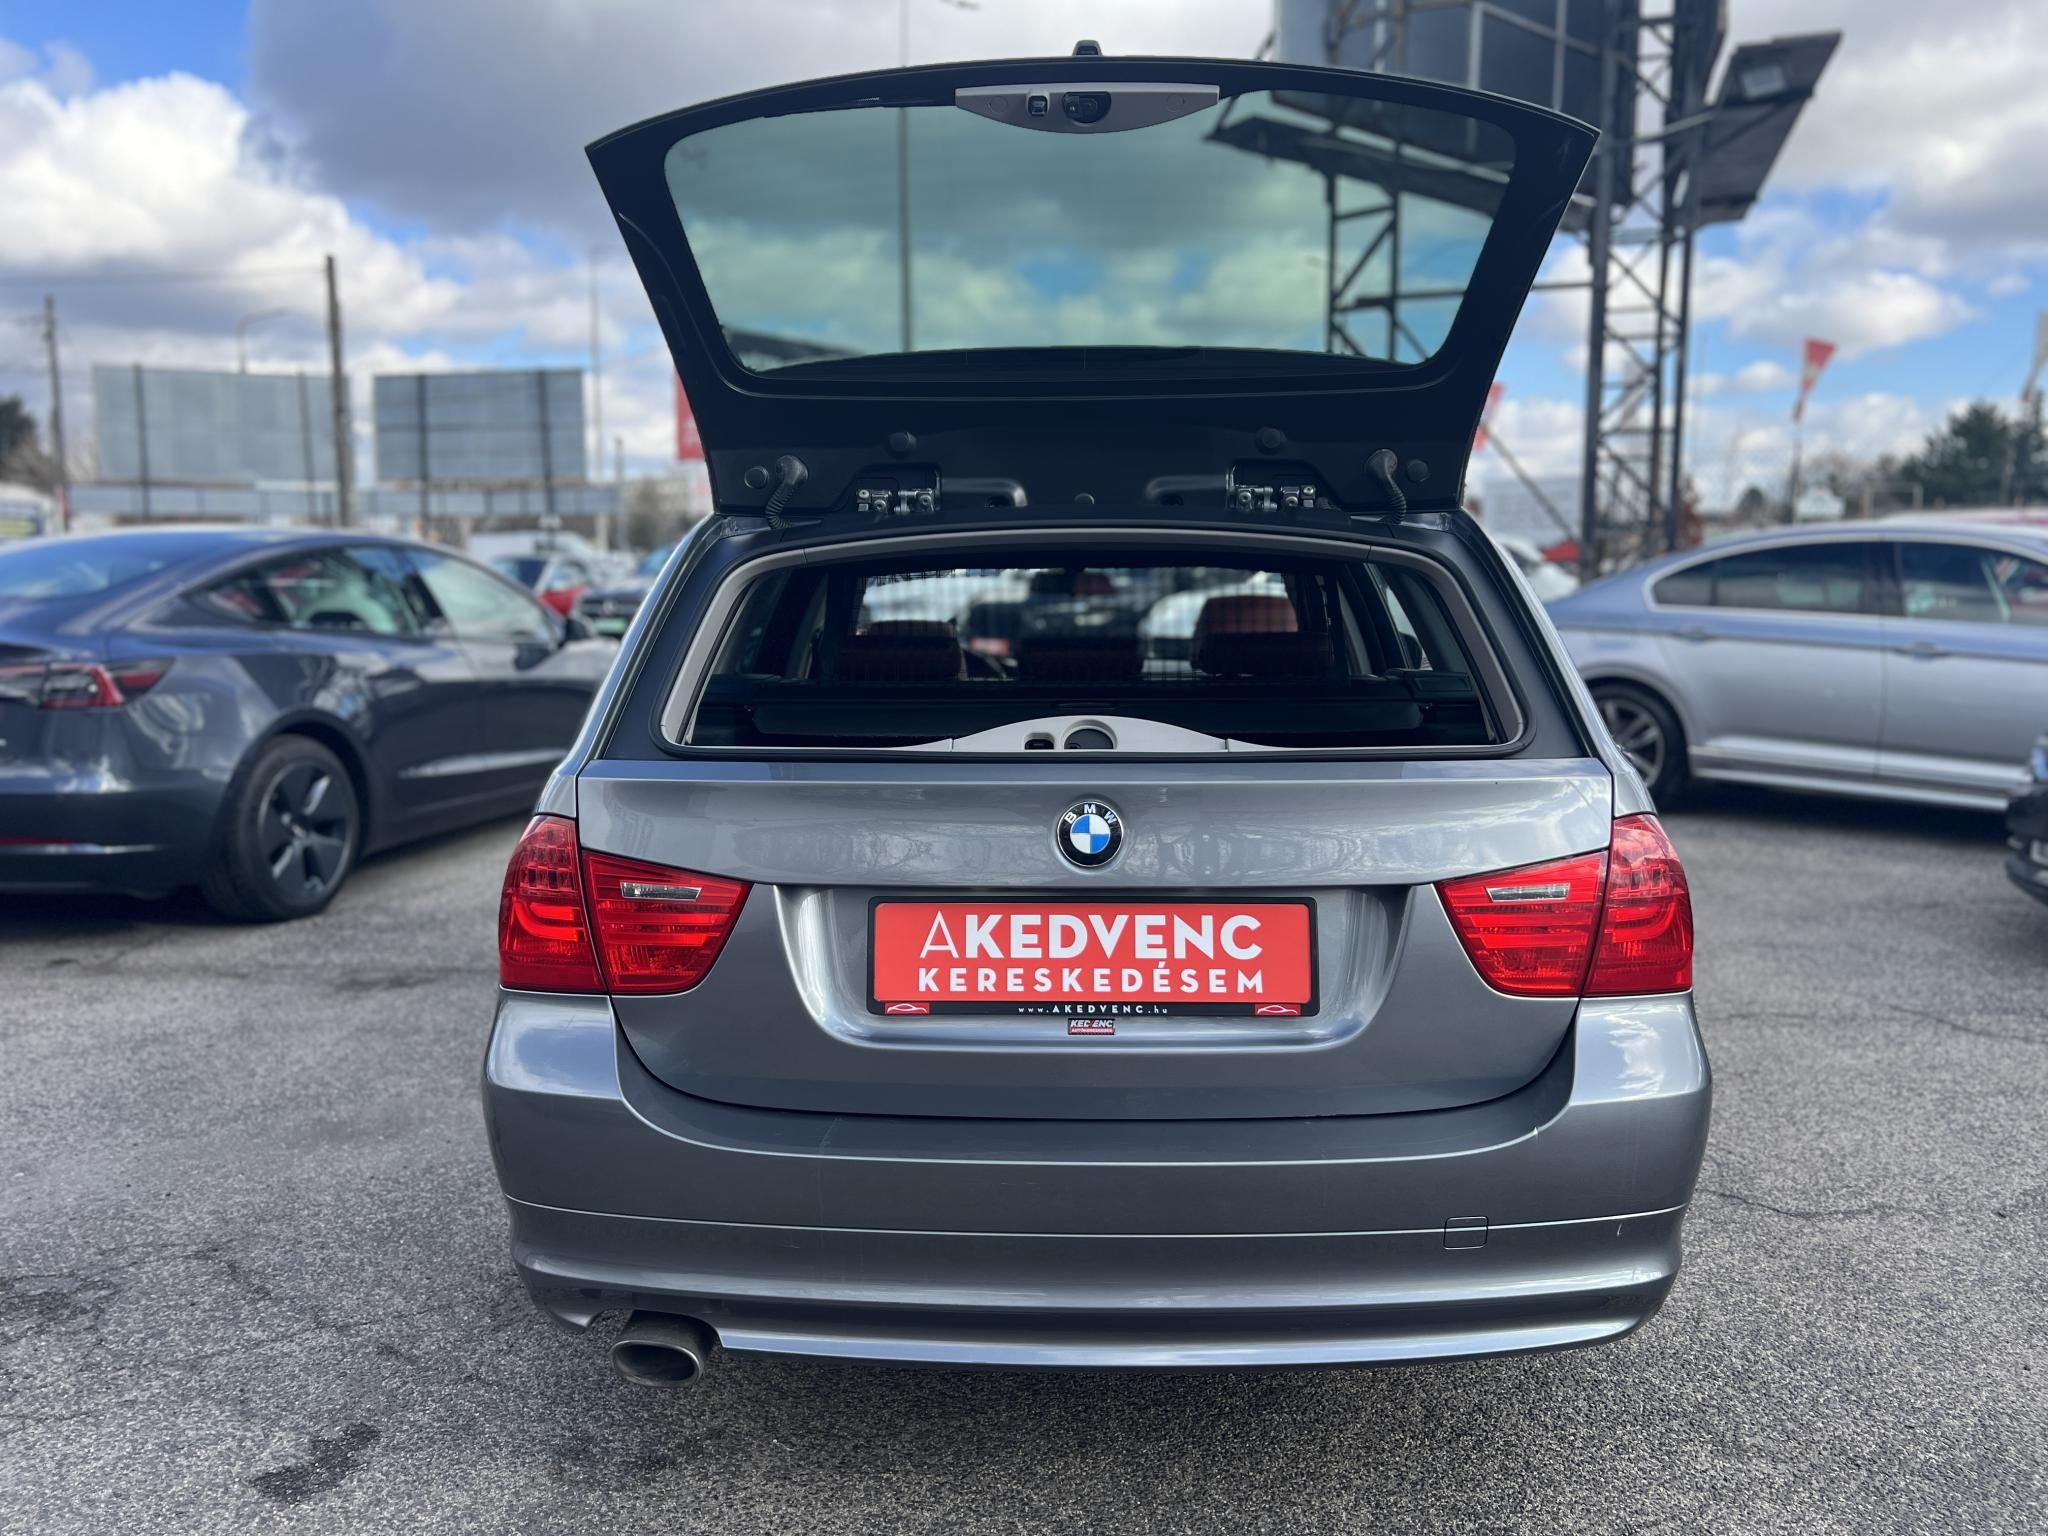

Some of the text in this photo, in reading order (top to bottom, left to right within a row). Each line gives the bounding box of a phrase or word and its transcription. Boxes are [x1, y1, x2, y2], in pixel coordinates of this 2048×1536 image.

[1064, 804, 1117, 824] BMW
[919, 910, 1263, 959] AKEDVENC
[919, 962, 1263, 993] KERESKEDÉSEM
[1018, 1005, 1168, 1014] www.AKEDVENC.hu
